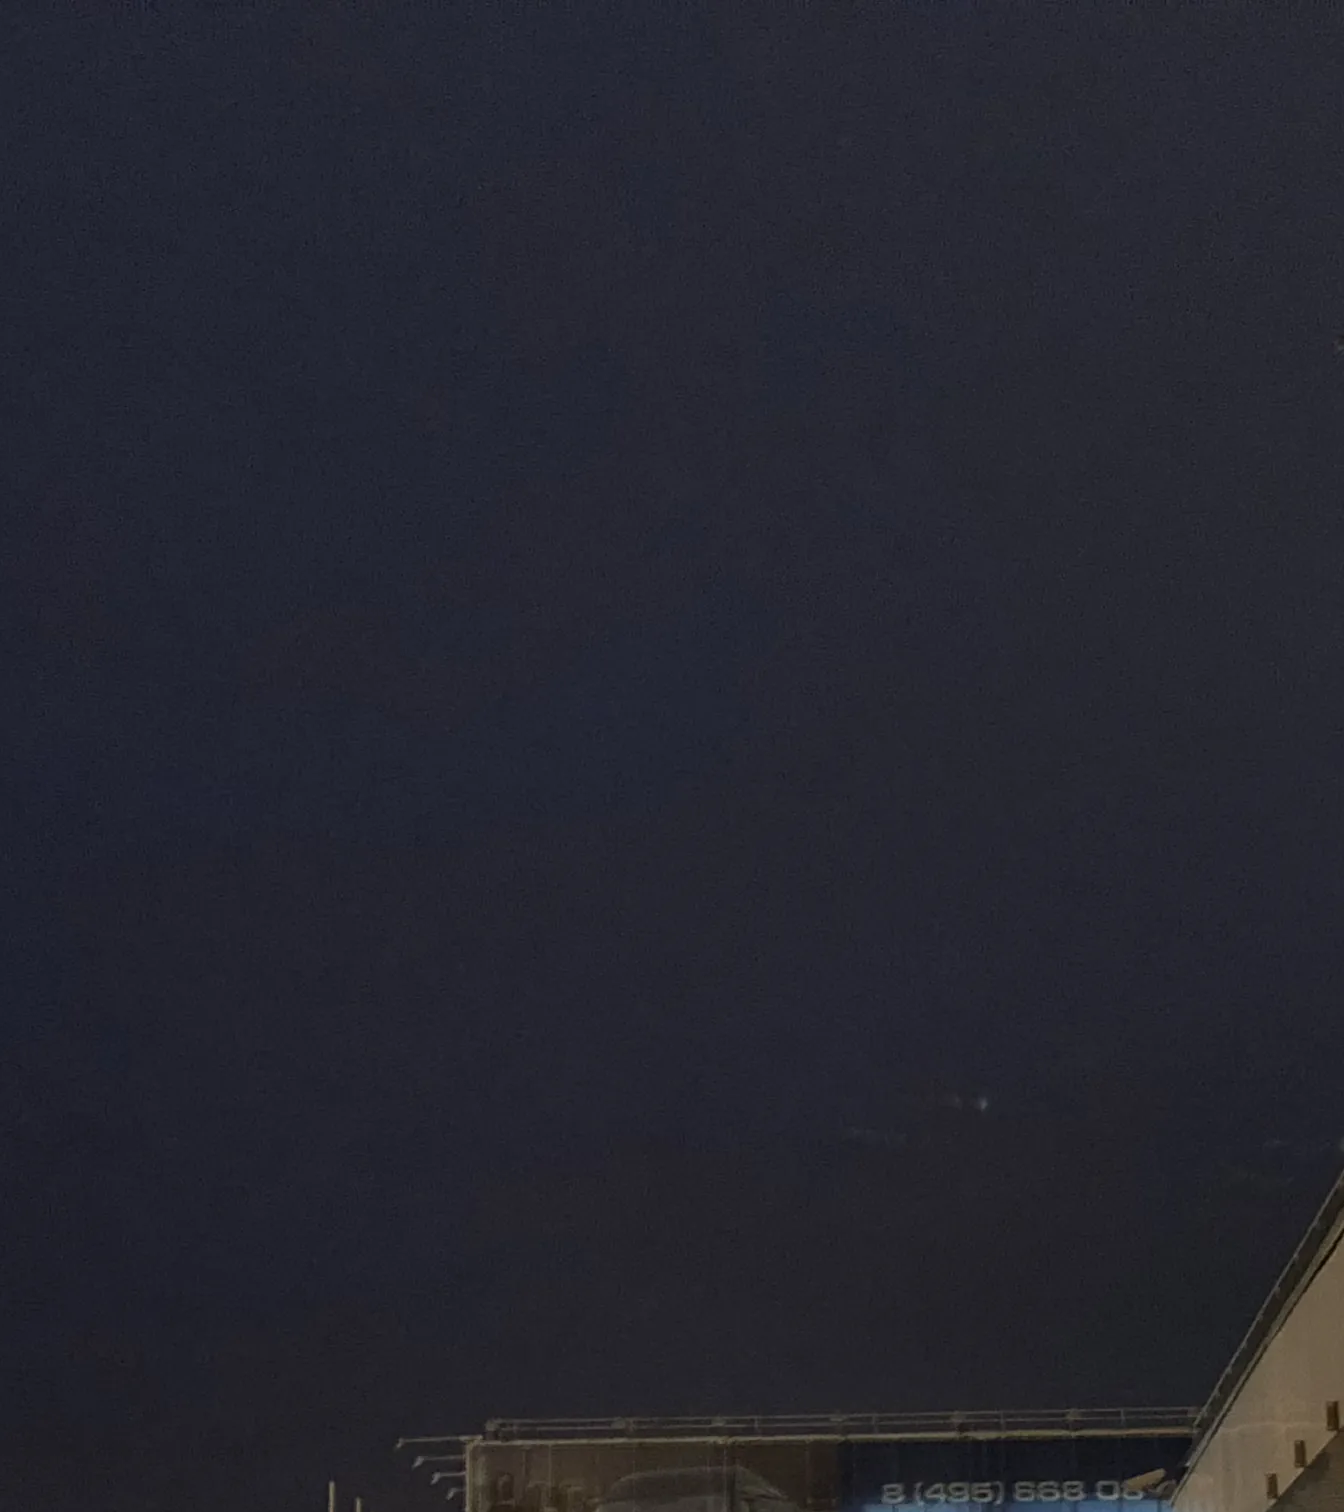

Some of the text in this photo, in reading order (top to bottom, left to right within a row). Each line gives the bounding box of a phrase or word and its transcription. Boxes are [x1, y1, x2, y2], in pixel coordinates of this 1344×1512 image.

[881, 1483, 906, 1504] 8
[913, 1482, 1004, 1506] (495)
[1014, 1480, 1086, 1501] 668
